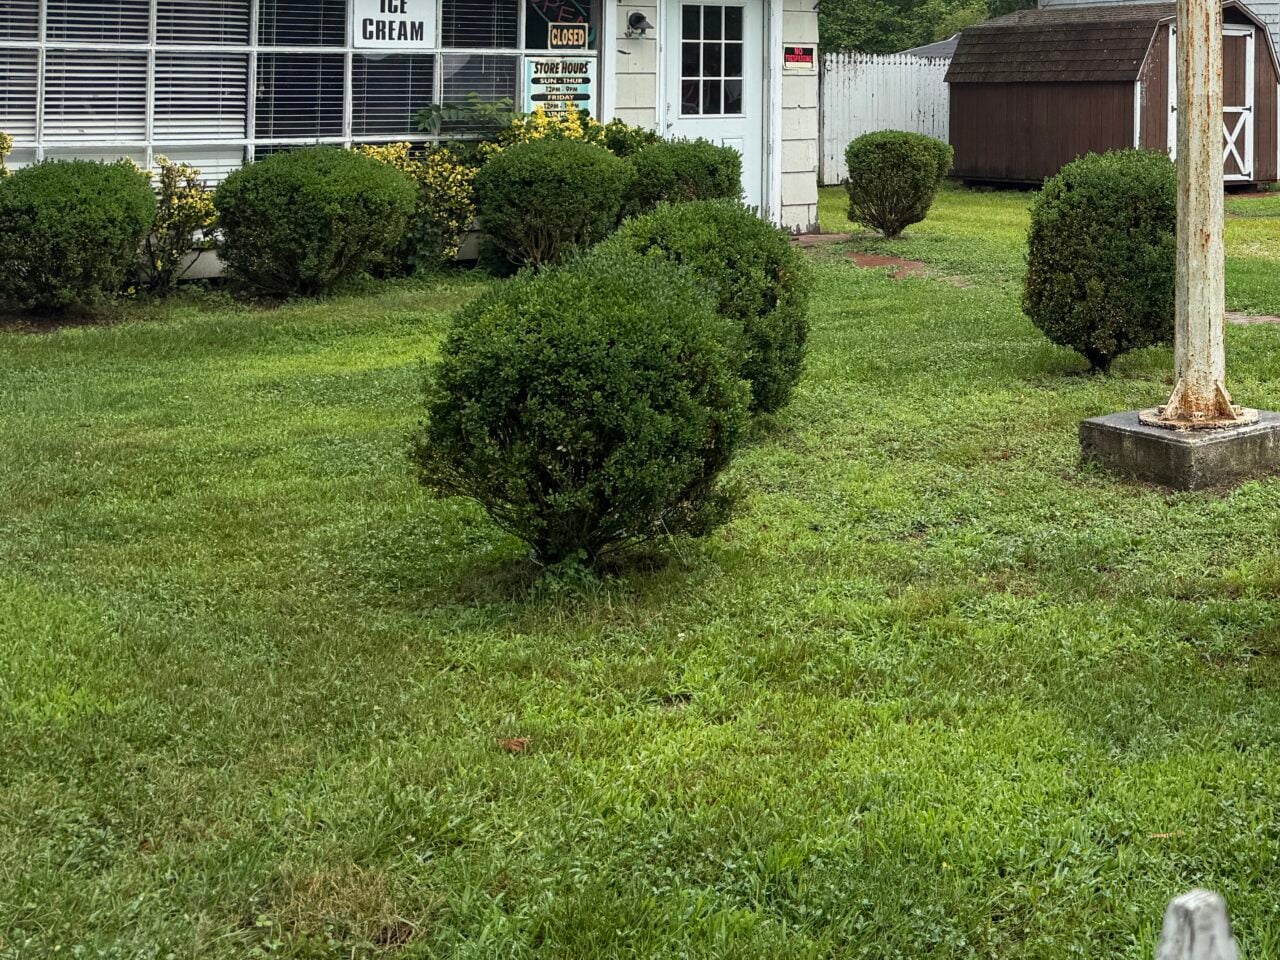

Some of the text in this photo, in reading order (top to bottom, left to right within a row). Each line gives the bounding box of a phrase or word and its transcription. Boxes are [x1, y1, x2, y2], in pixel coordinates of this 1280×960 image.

[362, 18, 424, 41] CREAM
[551, 28, 585, 46] CLOSED
[794, 47, 803, 55] NO
[533, 62, 589, 74] STORE HOURS
